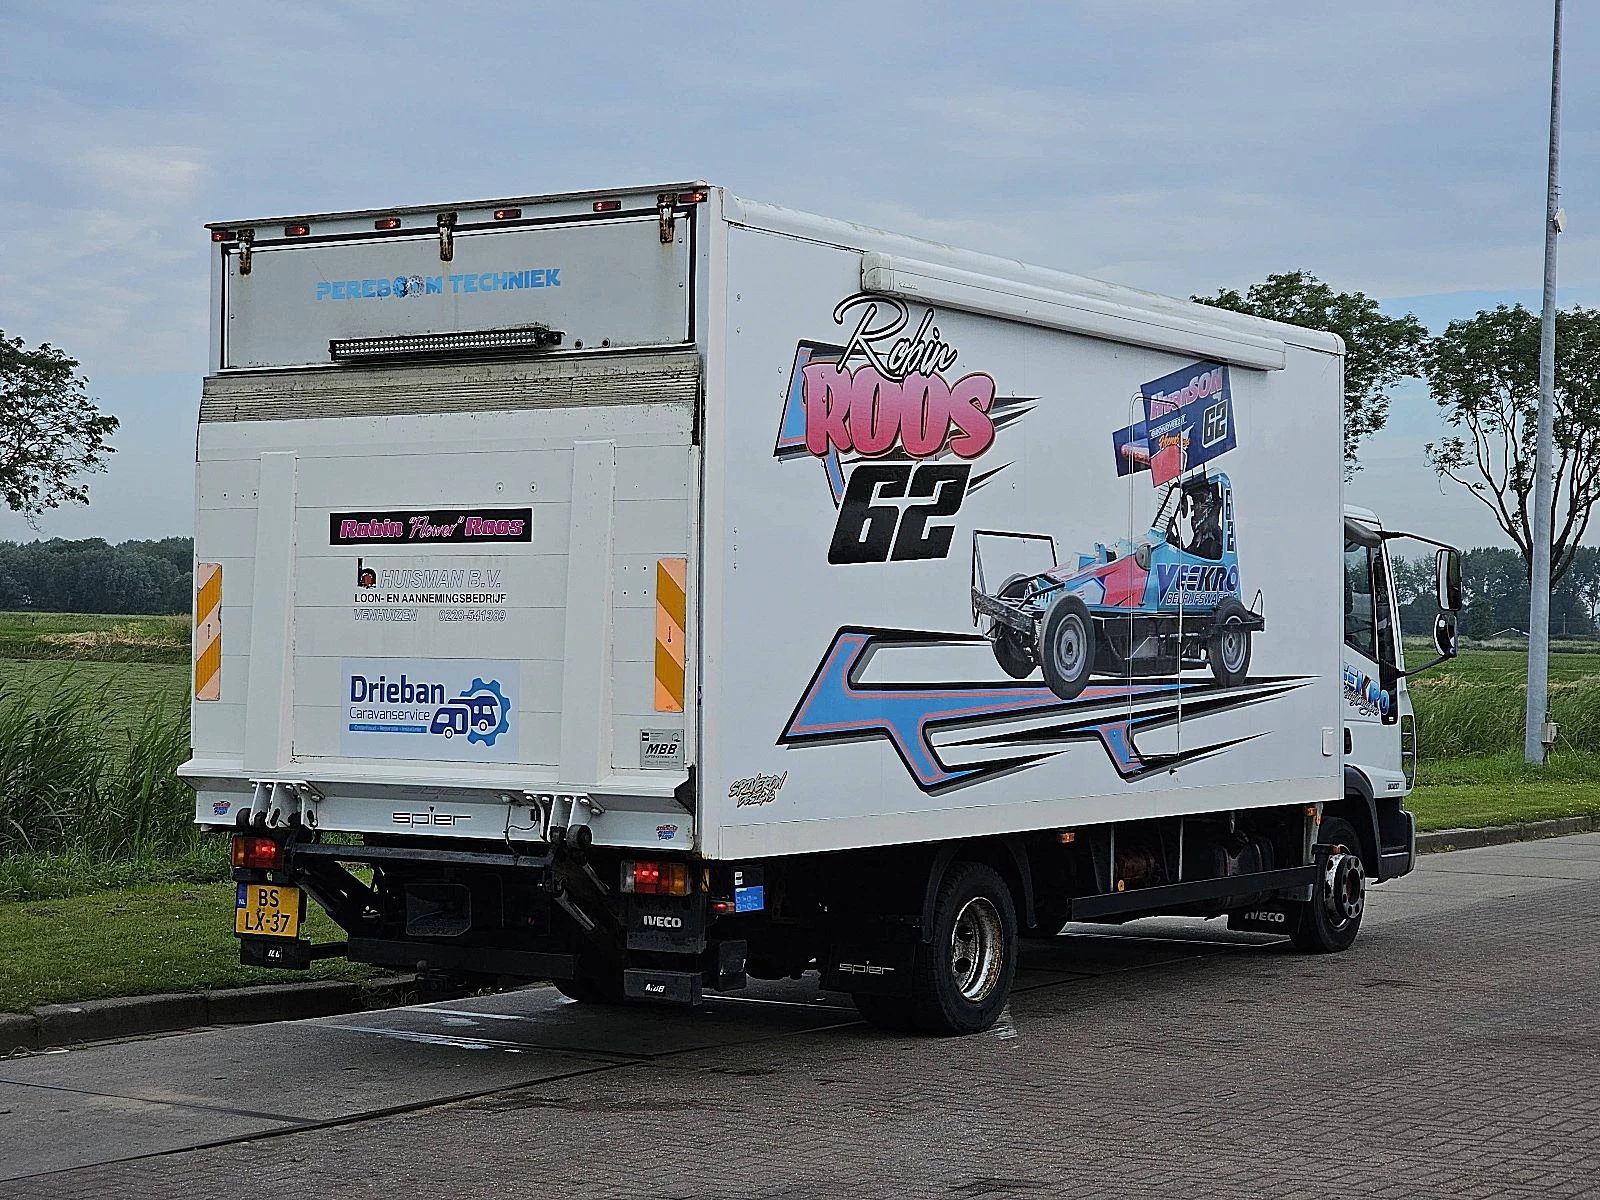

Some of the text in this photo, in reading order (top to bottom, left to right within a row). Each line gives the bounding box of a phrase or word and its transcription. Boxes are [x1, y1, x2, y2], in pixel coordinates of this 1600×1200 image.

[316, 268, 560, 300] PEREBOOM TECHNIEK
[834, 292, 957, 383] Robin
[802, 361, 996, 460] ROOS
[1203, 399, 1227, 448] 62
[828, 464, 972, 564] 62
[340, 518, 404, 538] Robin
[464, 516, 525, 536] Roos
[380, 569, 464, 588] HUISMAN
[467, 569, 501, 588] B.V.
[1156, 563, 1240, 605] VEEKRO
[354, 593, 507, 604] LOON- EN AANNEMINGSBEDRIJF
[354, 608, 418, 621] VENHUIZEN
[350, 674, 445, 704] Drieban
[349, 706, 431, 721] Caravanservice
[645, 743, 678, 755] MBB
[392, 806, 472, 828] spier
[258, 888, 280, 908] BS
[245, 911, 291, 933] LX-37
[643, 915, 682, 928] IVECO
[1244, 910, 1285, 922] IVECO
[838, 960, 895, 975] spier
